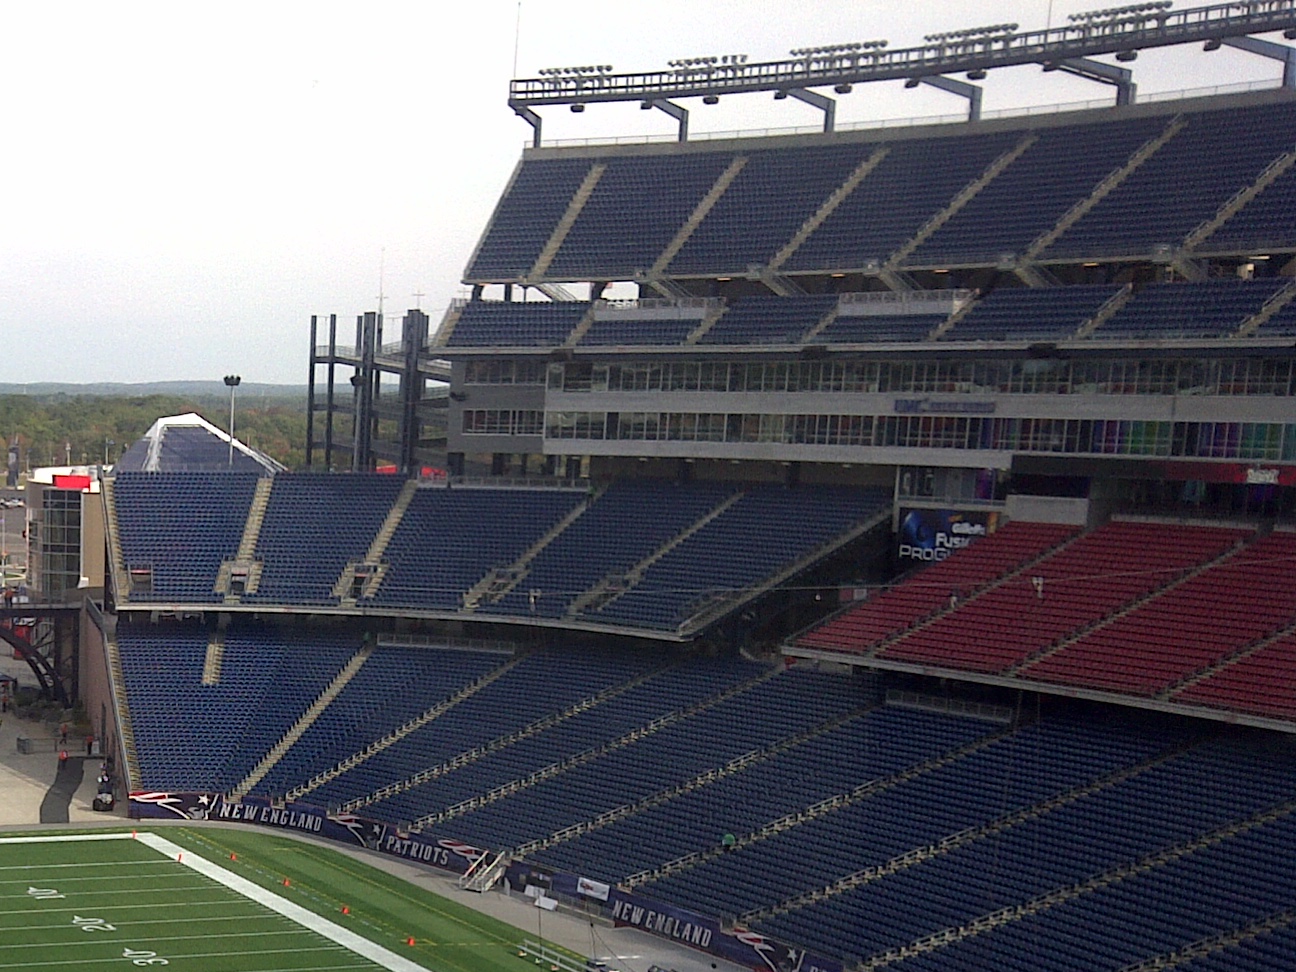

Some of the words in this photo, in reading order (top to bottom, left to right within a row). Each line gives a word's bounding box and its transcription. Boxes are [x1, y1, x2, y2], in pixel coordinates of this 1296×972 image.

[219, 803, 257, 820] NEW
[260, 807, 323, 832] ENGLAND
[386, 834, 449, 866] PATRIOTS
[612, 900, 645, 925] NEW
[645, 911, 712, 948] ENGLAND
